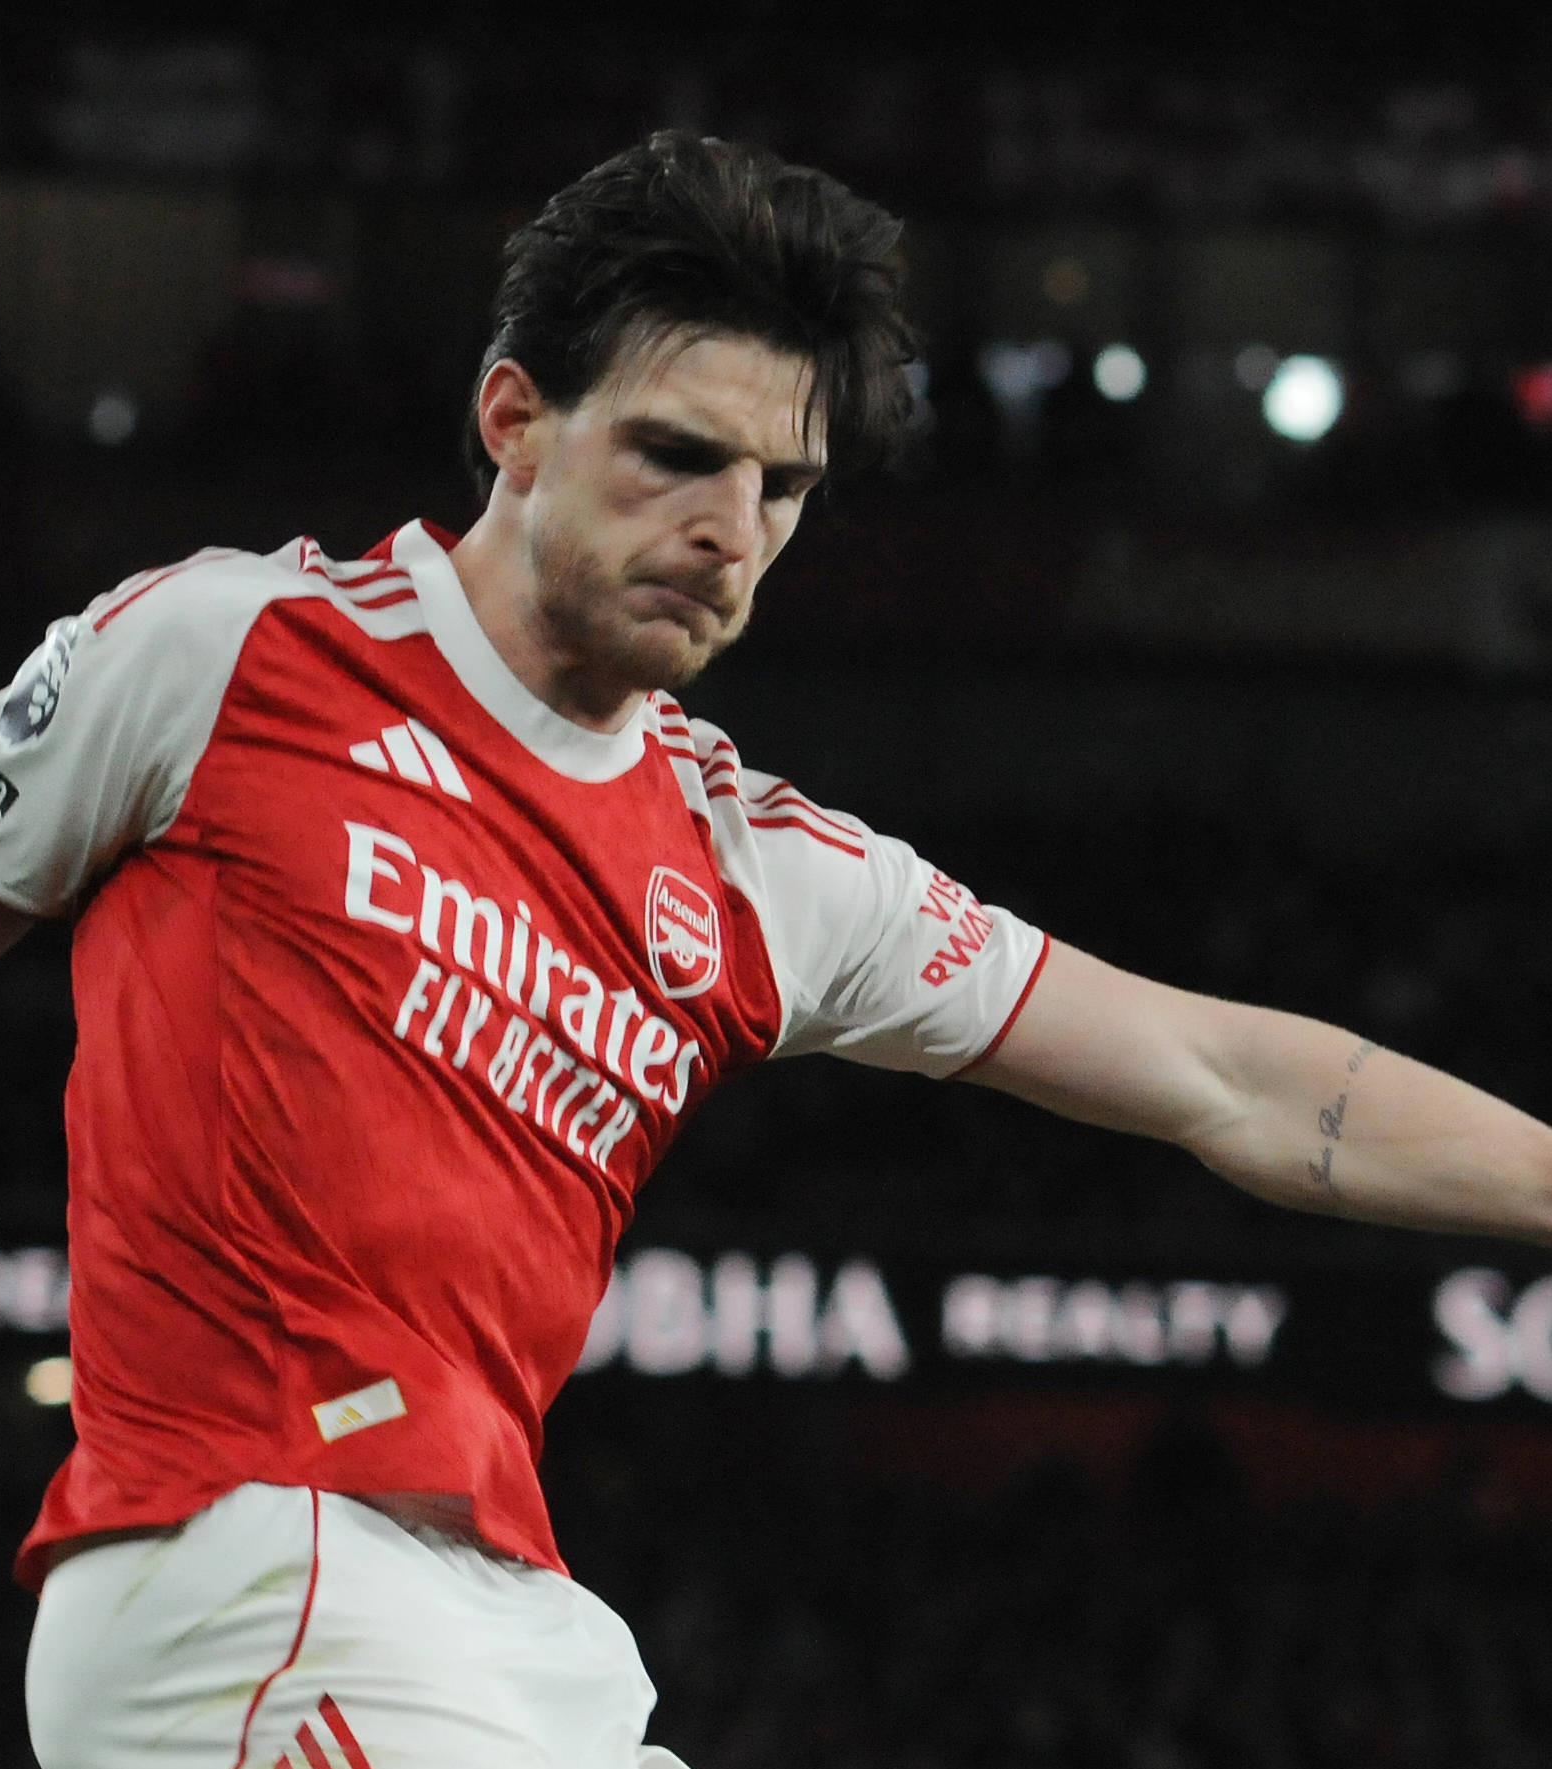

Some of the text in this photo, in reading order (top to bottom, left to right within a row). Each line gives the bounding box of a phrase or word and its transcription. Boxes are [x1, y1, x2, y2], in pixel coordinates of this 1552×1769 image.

[657, 885, 709, 937] Arsenal
[918, 869, 962, 922] VIS
[344, 819, 704, 1115] Emirates
[394, 958, 639, 1174] FLY BETTER
